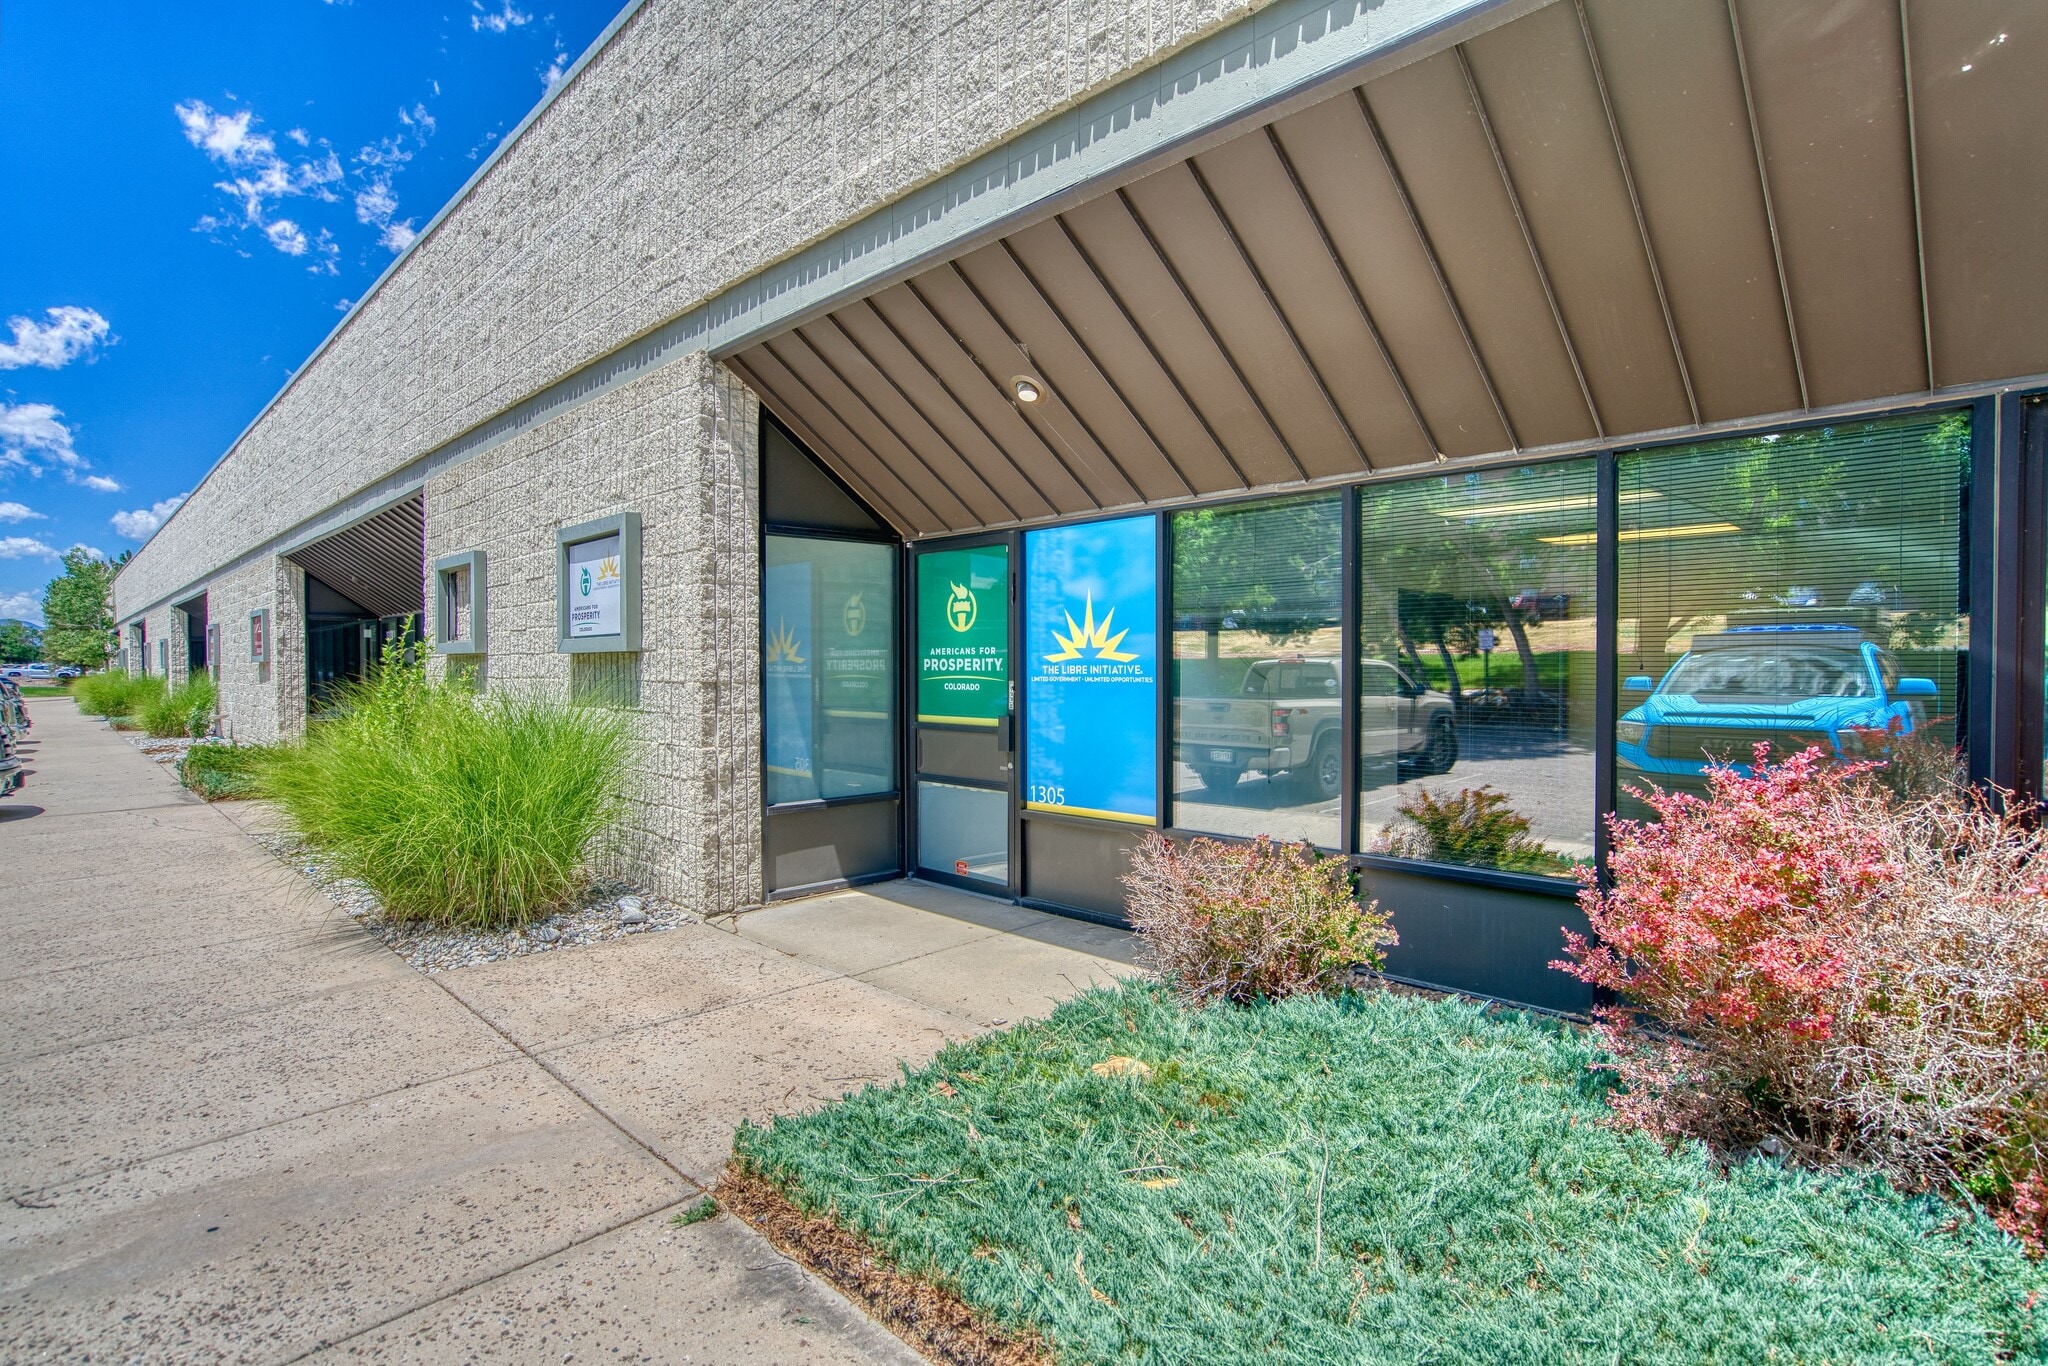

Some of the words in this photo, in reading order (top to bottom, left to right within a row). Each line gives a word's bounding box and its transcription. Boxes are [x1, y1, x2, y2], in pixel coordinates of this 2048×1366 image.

[572, 611, 600, 621] PROSPERITY
[930, 647, 976, 656] AMERICANS
[979, 646, 996, 655] FOR
[1042, 665, 1060, 674] THE
[1061, 664, 1088, 674] LIBRE
[944, 683, 980, 691] COLORADO
[1030, 785, 1065, 805] 1305
